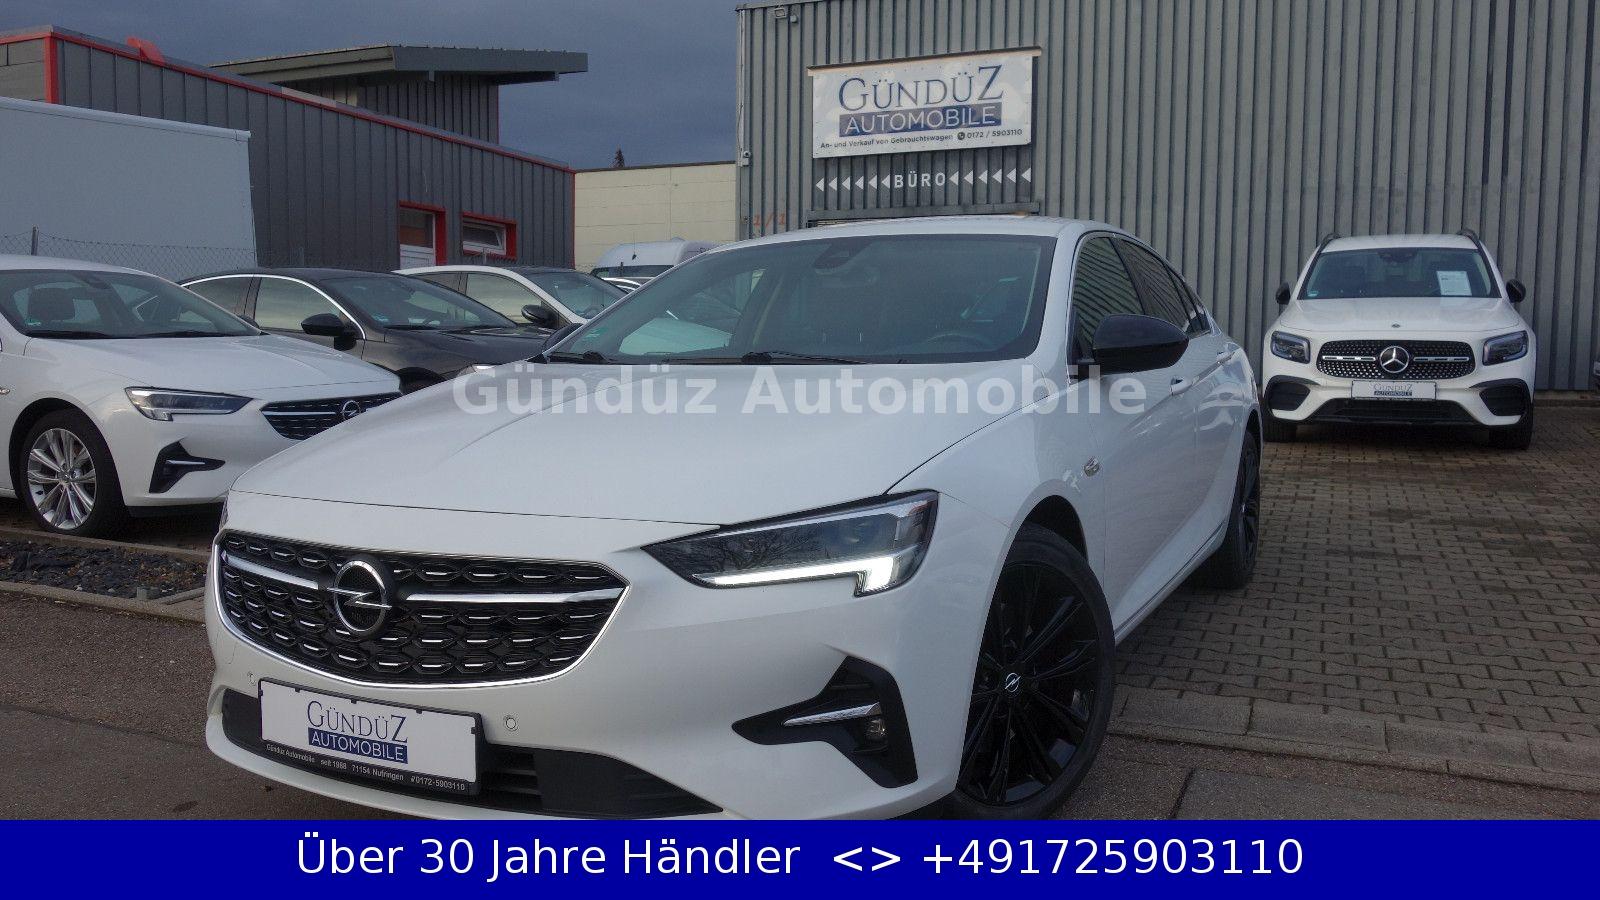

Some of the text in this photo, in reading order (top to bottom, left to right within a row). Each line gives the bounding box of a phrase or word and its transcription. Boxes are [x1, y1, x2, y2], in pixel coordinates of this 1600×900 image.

[839, 64, 1003, 111] GÜNDÜZ
[845, 106, 996, 135] AUTOMOBILE
[849, 139, 874, 147] Verkauf
[890, 134, 953, 144] Gebrauchtswagen
[967, 131, 983, 139] 0172
[992, 129, 1023, 137] 5903110
[894, 171, 946, 188] BÜRO
[307, 700, 409, 743] GÜNDÜZ
[311, 730, 405, 762] AUTOMOBILE
[352, 764, 371, 774] 71154
[372, 768, 404, 781] Nufringen
